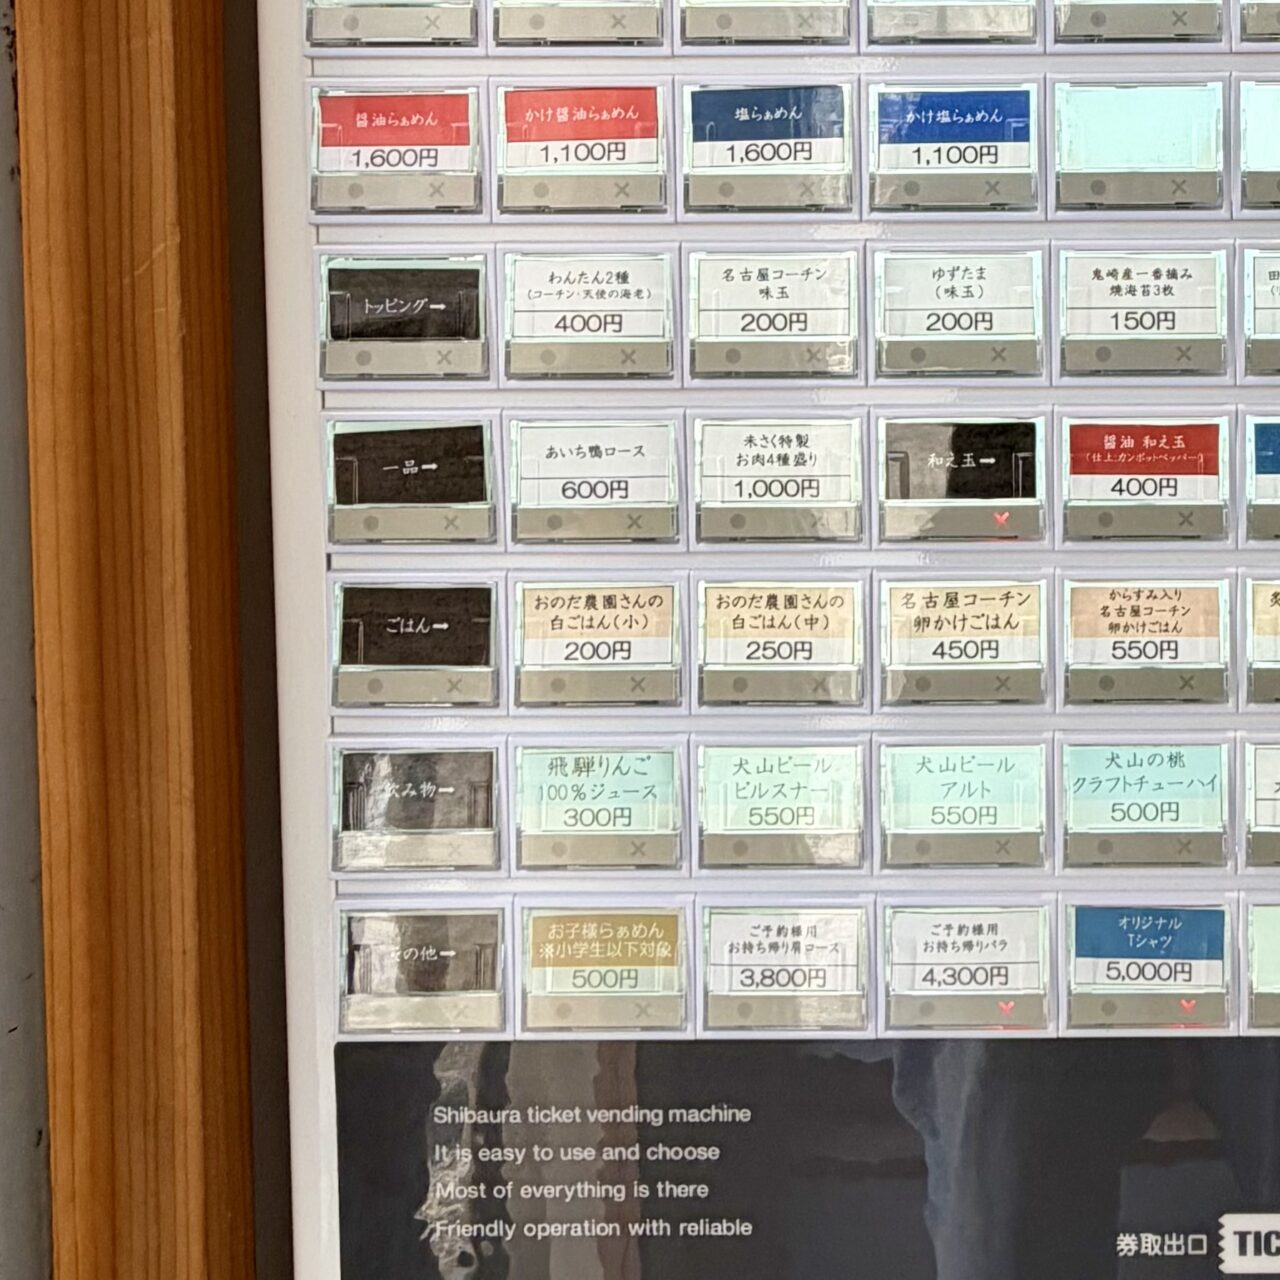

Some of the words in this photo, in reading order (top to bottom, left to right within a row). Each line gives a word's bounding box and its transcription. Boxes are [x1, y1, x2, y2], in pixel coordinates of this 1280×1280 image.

[356, 113, 438, 127] 醤油らぁめん
[526, 106, 638, 121] かけ醤油らぁめん
[735, 106, 802, 120] 塩らぁめん
[906, 109, 1003, 124] かけ塩らぁめん
[352, 148, 438, 169] 1,600円
[540, 142, 626, 164] 1,100円
[726, 141, 813, 163] 1,600円
[912, 145, 998, 166] 1,100円
[549, 271, 630, 285] わんたん2種
[722, 267, 827, 282] 名古屋コーチン
[932, 266, 987, 281] ゆずたま
[759, 285, 790, 300] 味玉
[364, 298, 428, 314] トッピング
[554, 314, 622, 334] 400円
[741, 312, 808, 333] 200円
[926, 312, 993, 332] 200円
[1110, 310, 1176, 331] 150円
[1104, 434, 1135, 449] 醤油
[1144, 434, 1186, 449] 和え玉
[562, 480, 629, 500] 600円
[734, 479, 820, 499] 1,000円
[1111, 477, 1178, 497] 400円
[535, 595, 663, 611] おのだ農園さんの
[716, 594, 844, 610] おのだ農園さんの
[902, 592, 1032, 609] 名古屋コーチン
[1100, 605, 1191, 618] 名古屋コーチン
[386, 618, 430, 634] ごはん
[914, 613, 1020, 632] 卵かけごはん
[1108, 621, 1182, 634] 卵かけごはん
[564, 641, 631, 661] 200円
[746, 641, 813, 661] 250円
[932, 640, 999, 660] 450円
[1112, 640, 1178, 660] 550円
[548, 755, 652, 777] 飛騨りんご
[733, 756, 832, 776] 犬山ビール
[917, 755, 1015, 774] 犬山ビール
[1106, 751, 1186, 769] 犬山の桃
[941, 780, 991, 799] アルト
[1073, 774, 1218, 794] クラフトチューハイ
[563, 807, 632, 828] 300円
[749, 806, 815, 826] 550円
[931, 805, 998, 825] 550円
[1111, 802, 1180, 822] 500円
[549, 923, 664, 939] お子様らぁめん
[1119, 916, 1182, 931] オリジナル
[572, 969, 639, 989] 500円
[740, 968, 827, 989] 3,800円
[922, 966, 1009, 987] 4,300円
[1106, 961, 1192, 982] 5,000円
[433, 1106, 521, 1124] Shibaura
[528, 1106, 582, 1123] ticket
[587, 1105, 662, 1126] vending
[669, 1104, 752, 1122] machine
[434, 1145, 449, 1161] It
[456, 1144, 472, 1161] is
[478, 1146, 526, 1164] easy
[534, 1145, 553, 1160] to
[560, 1146, 596, 1160] use
[602, 1143, 640, 1160] and
[647, 1143, 720, 1160] choose
[436, 1182, 486, 1199] Most
[494, 1182, 512, 1198] of
[521, 1181, 625, 1201] everything
[634, 1181, 649, 1198] is
[657, 1181, 709, 1198] there
[435, 1220, 516, 1240] Friendly
[524, 1220, 620, 1238] operation
[629, 1220, 670, 1236] with
[679, 1220, 752, 1236] reliable
[1116, 1233, 1206, 1256] 券取出口
